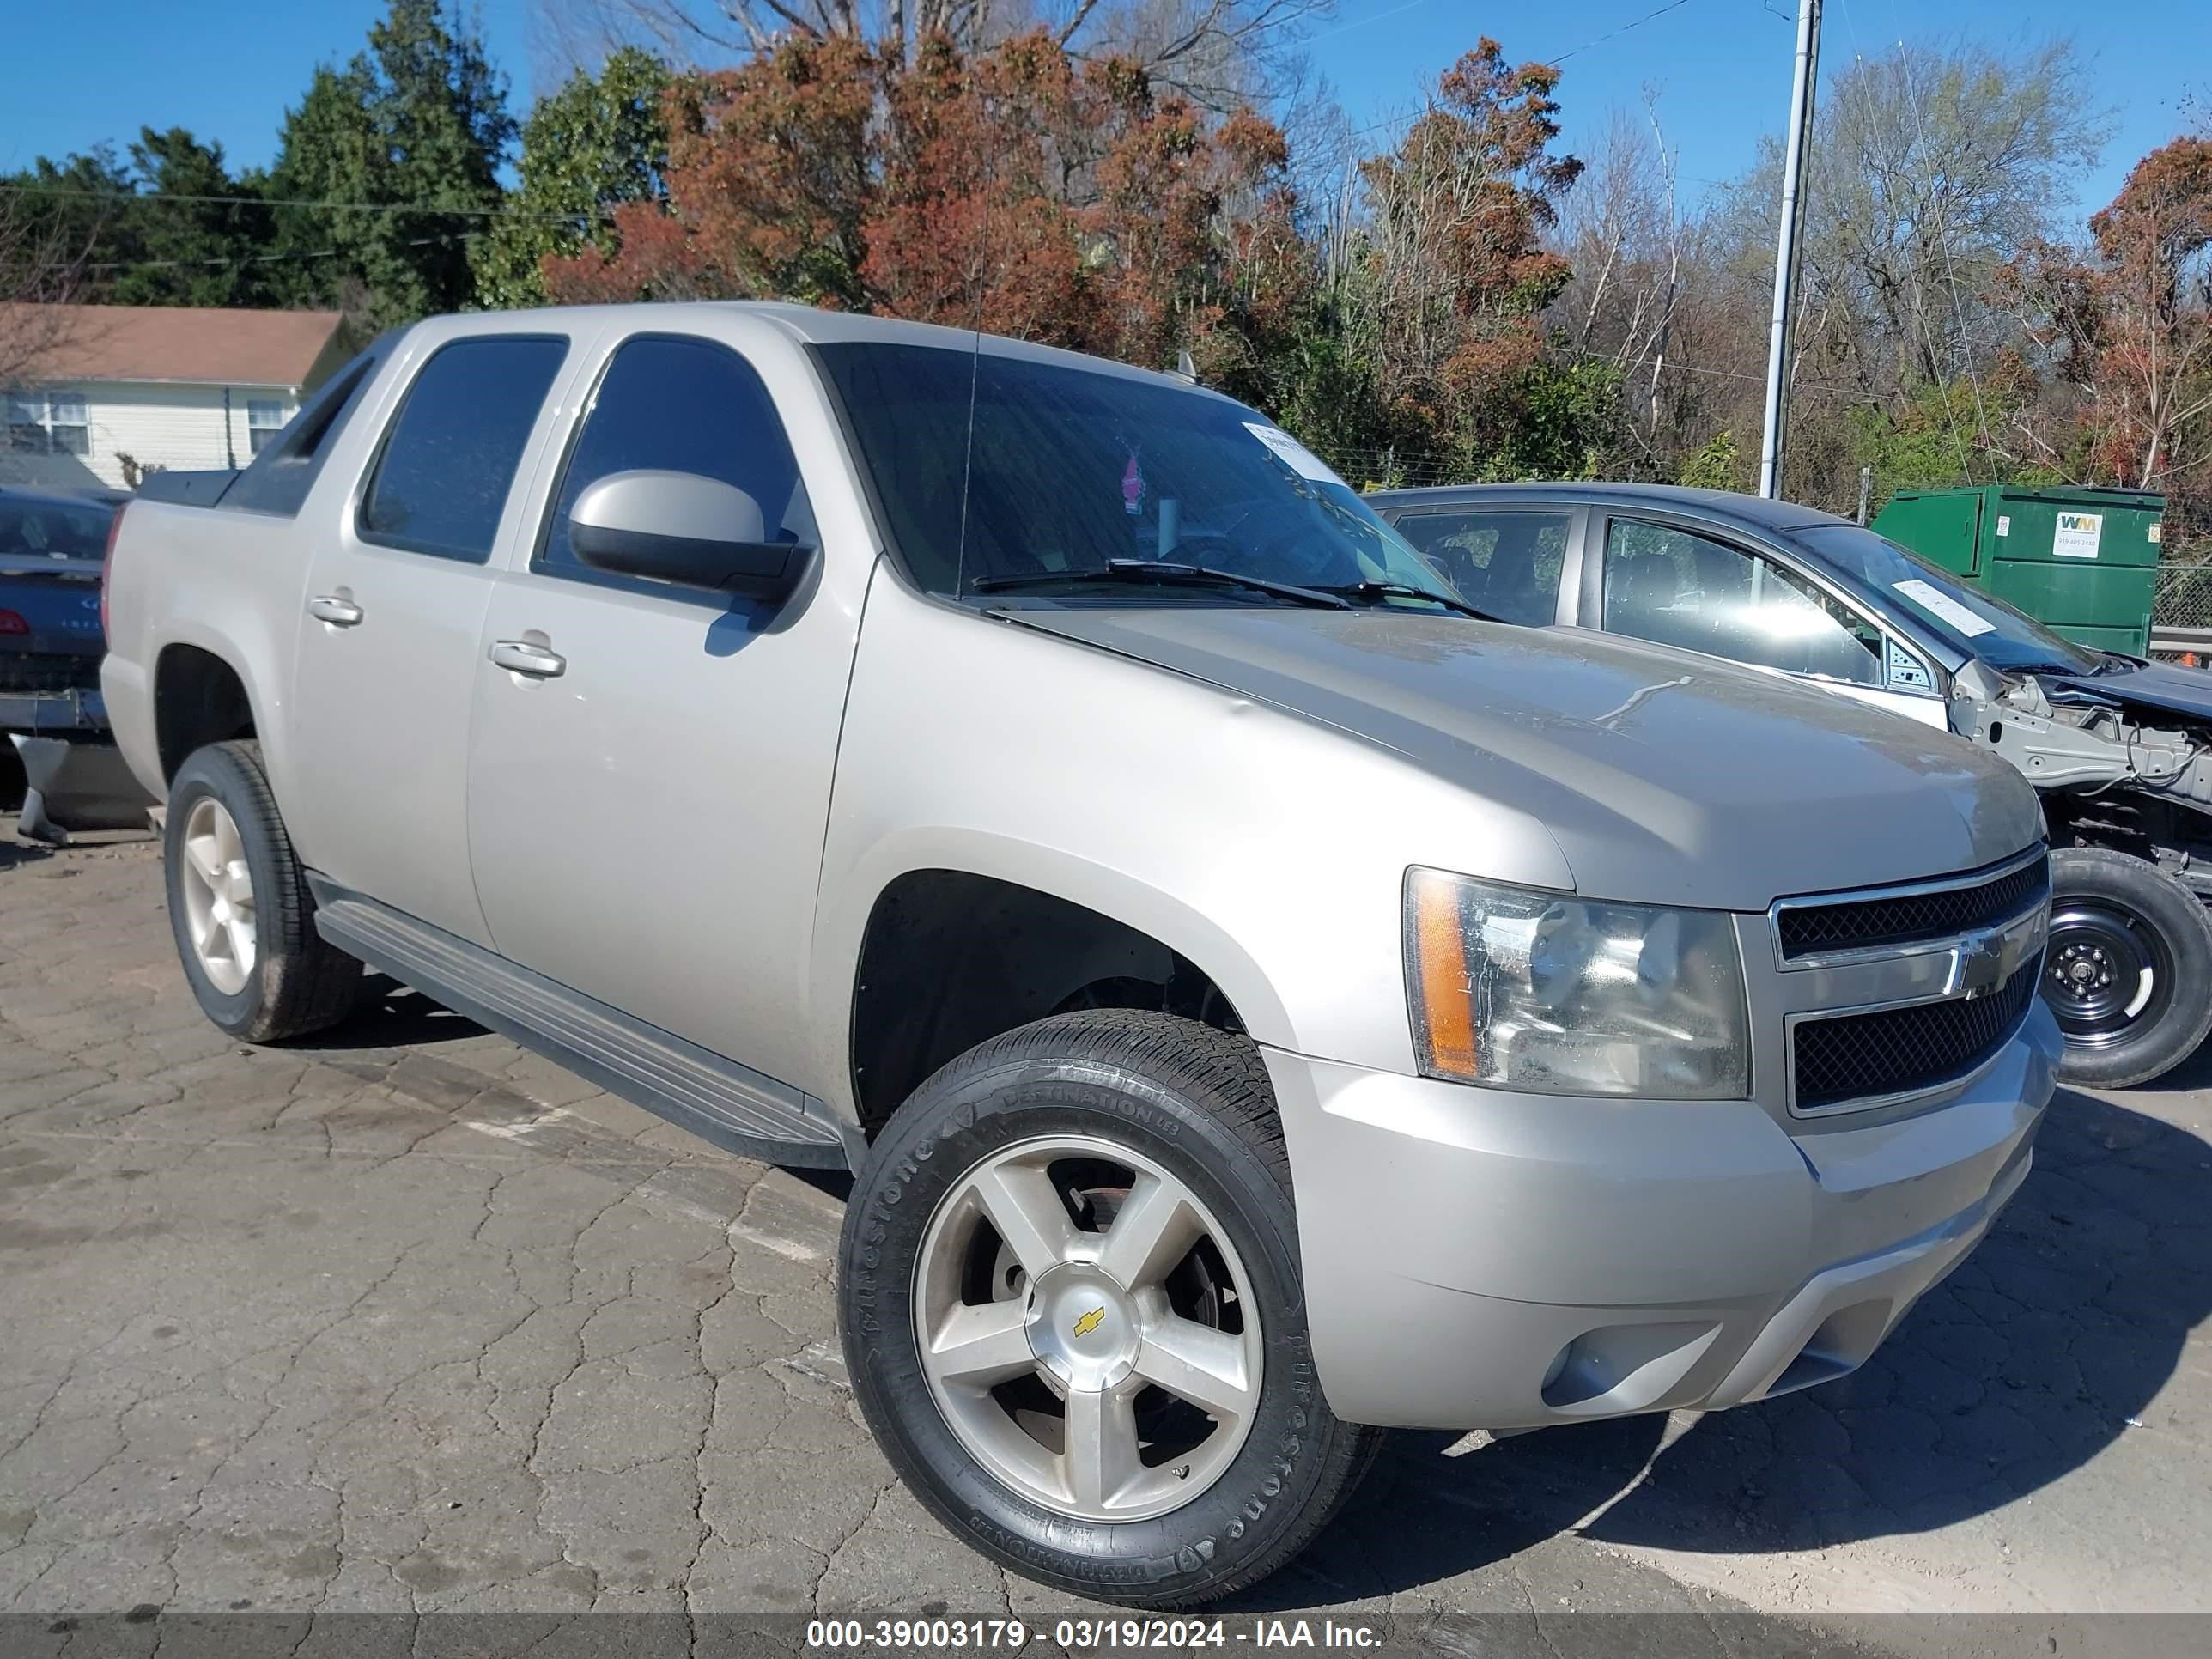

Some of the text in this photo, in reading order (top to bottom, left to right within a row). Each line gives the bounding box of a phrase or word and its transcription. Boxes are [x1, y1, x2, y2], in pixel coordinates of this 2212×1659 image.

[2061, 516, 2096, 531] WM
[1002, 1085, 1181, 1136] DESTINATION LE3
[855, 1139, 934, 1336] Firestone
[1225, 1329, 1314, 1540] Firestone
